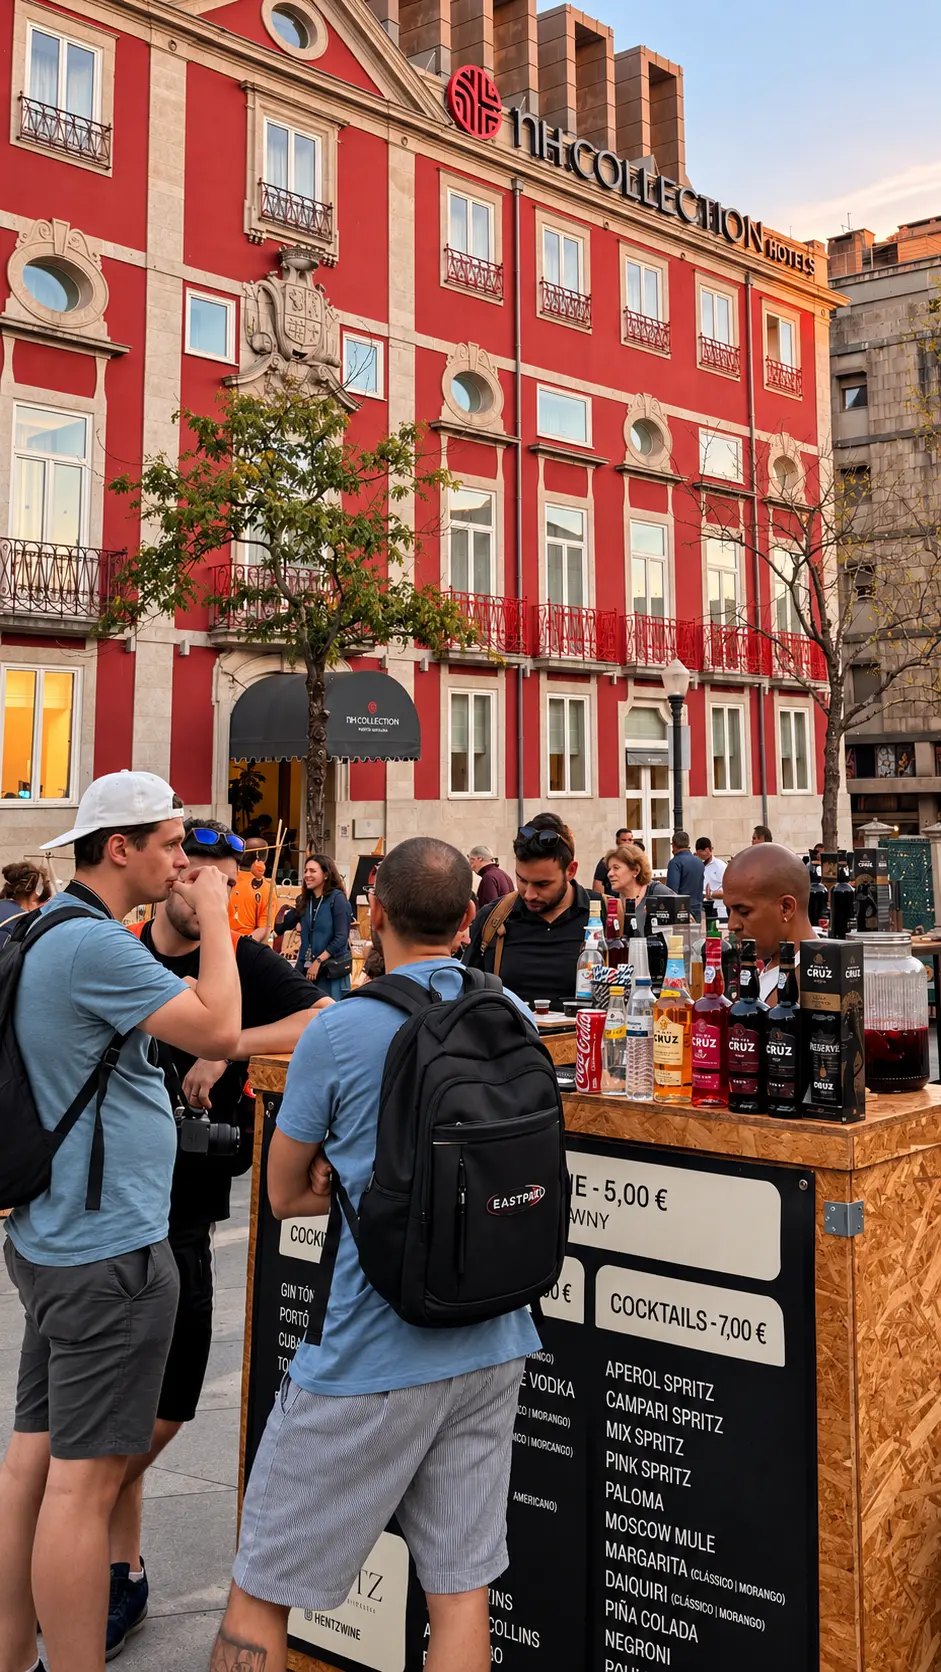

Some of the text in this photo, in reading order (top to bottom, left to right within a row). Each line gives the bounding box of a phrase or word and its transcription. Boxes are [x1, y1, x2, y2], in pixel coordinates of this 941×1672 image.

[565, 139, 765, 254] COLLECTION
[765, 238, 816, 276] HOTELS
[357, 716, 400, 726] COLLECTION
[807, 968, 833, 979] CRUZ
[692, 1036, 717, 1048] CRUZ
[728, 1041, 755, 1052] CRUZ
[766, 1044, 793, 1056] CRUZ
[604, 1179, 649, 1208] 5,00
[655, 1188, 668, 1212] €
[281, 1282, 297, 1300] GIN
[562, 1283, 572, 1303] €
[610, 1292, 708, 1332] COCKTAILS
[756, 1321, 767, 1345] €
[529, 1371, 576, 1399] VODKA
[605, 1360, 715, 1402] APEROL SPRITZ
[531, 1408, 571, 1429] MORANGO)
[606, 1390, 724, 1434] CAMPARI SPRITZ
[606, 1420, 684, 1456] MIX SPRITZ
[606, 1450, 692, 1487] PINK SPRITZ
[513, 1491, 558, 1513] AMERICANO)
[605, 1481, 665, 1511] PALOMA
[605, 1510, 716, 1553] MOSCOW MULE
[605, 1540, 688, 1578] MARGARITA
[690, 1567, 733, 1590] (CLÁSSICO
[738, 1582, 786, 1606] MORANGO)
[605, 1569, 668, 1603] DAIQUIRI
[671, 1592, 714, 1615] (CLÁSSICO
[718, 1607, 766, 1632] MORANGO)
[314, 1612, 361, 1641] HENTZWINE
[605, 1599, 699, 1643] PIÑA COLADA
[605, 1629, 671, 1665] NEGRONI
